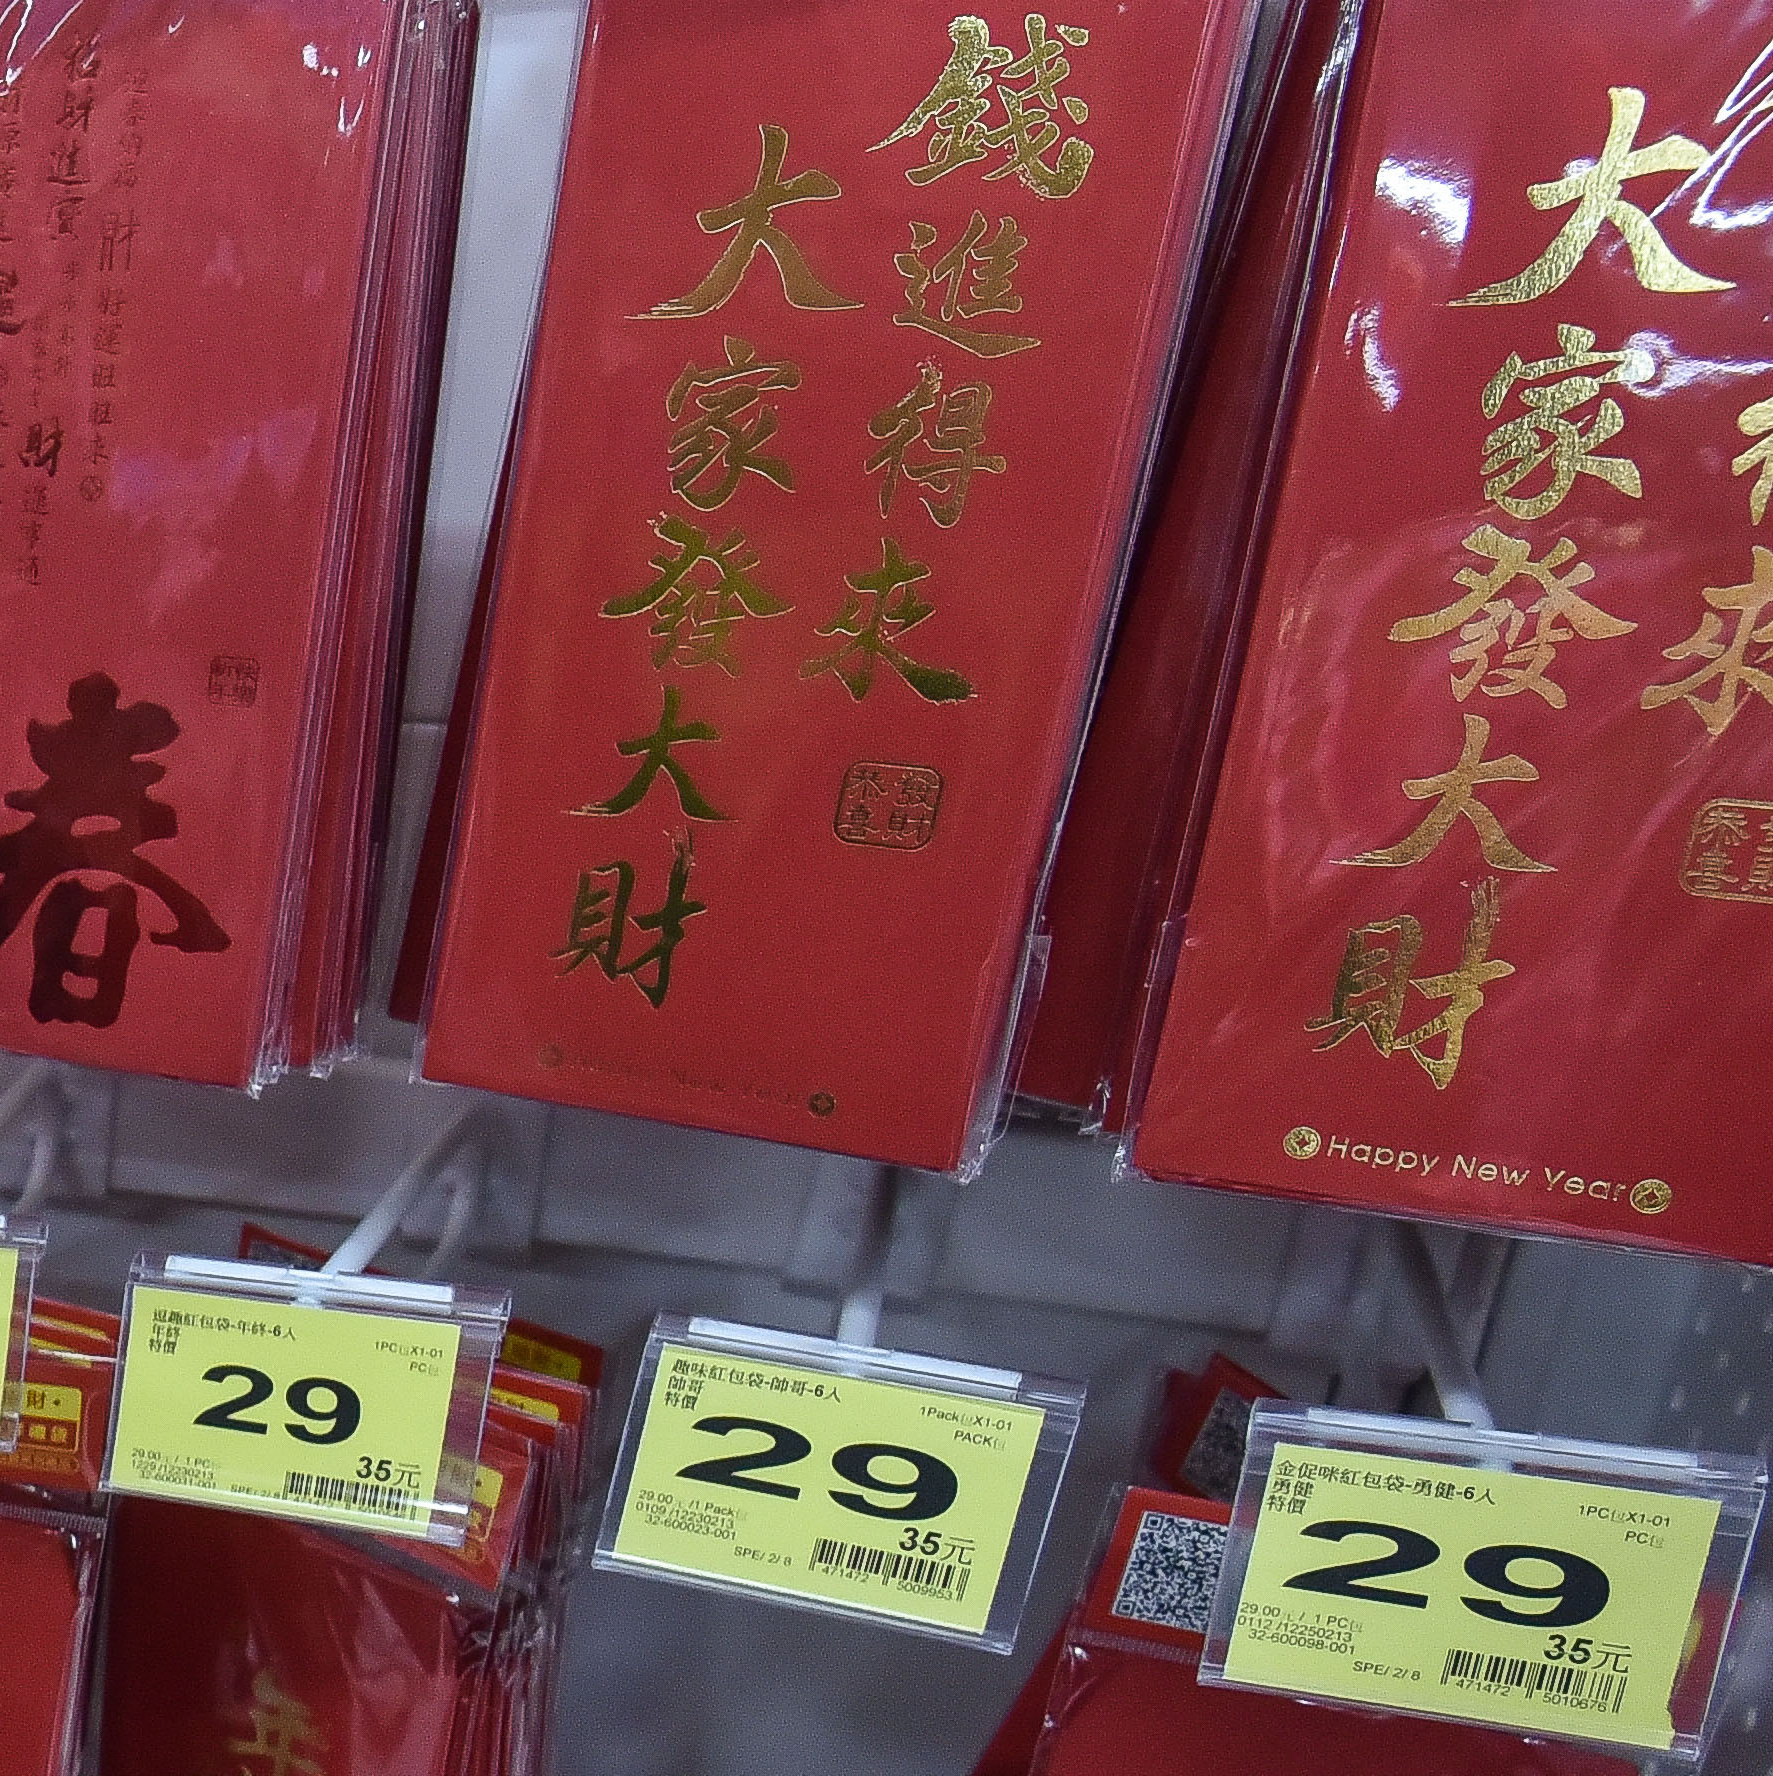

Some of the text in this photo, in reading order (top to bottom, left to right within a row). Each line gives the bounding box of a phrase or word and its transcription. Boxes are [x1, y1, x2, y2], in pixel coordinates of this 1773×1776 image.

[798, 12, 1095, 706] 錢進得來
[547, 123, 864, 1010] 大家發大財
[1303, 85, 1737, 1090] 大家發大財
[1326, 1135, 1629, 1203] Happy New Year
[193, 1364, 362, 1446] 29
[663, 1390, 700, 1412] 特價
[356, 1456, 422, 1490] 35元
[675, 1415, 959, 1522] 29
[1271, 1478, 1315, 1500] 勇健
[1266, 1494, 1308, 1515] 特價
[898, 1526, 976, 1566] 35元
[1281, 1519, 1611, 1629] 29
[1237, 1614, 1274, 1631] 0112
[1542, 1633, 1633, 1675] 35元
[1455, 1678, 1608, 1714] 471472 5010676
